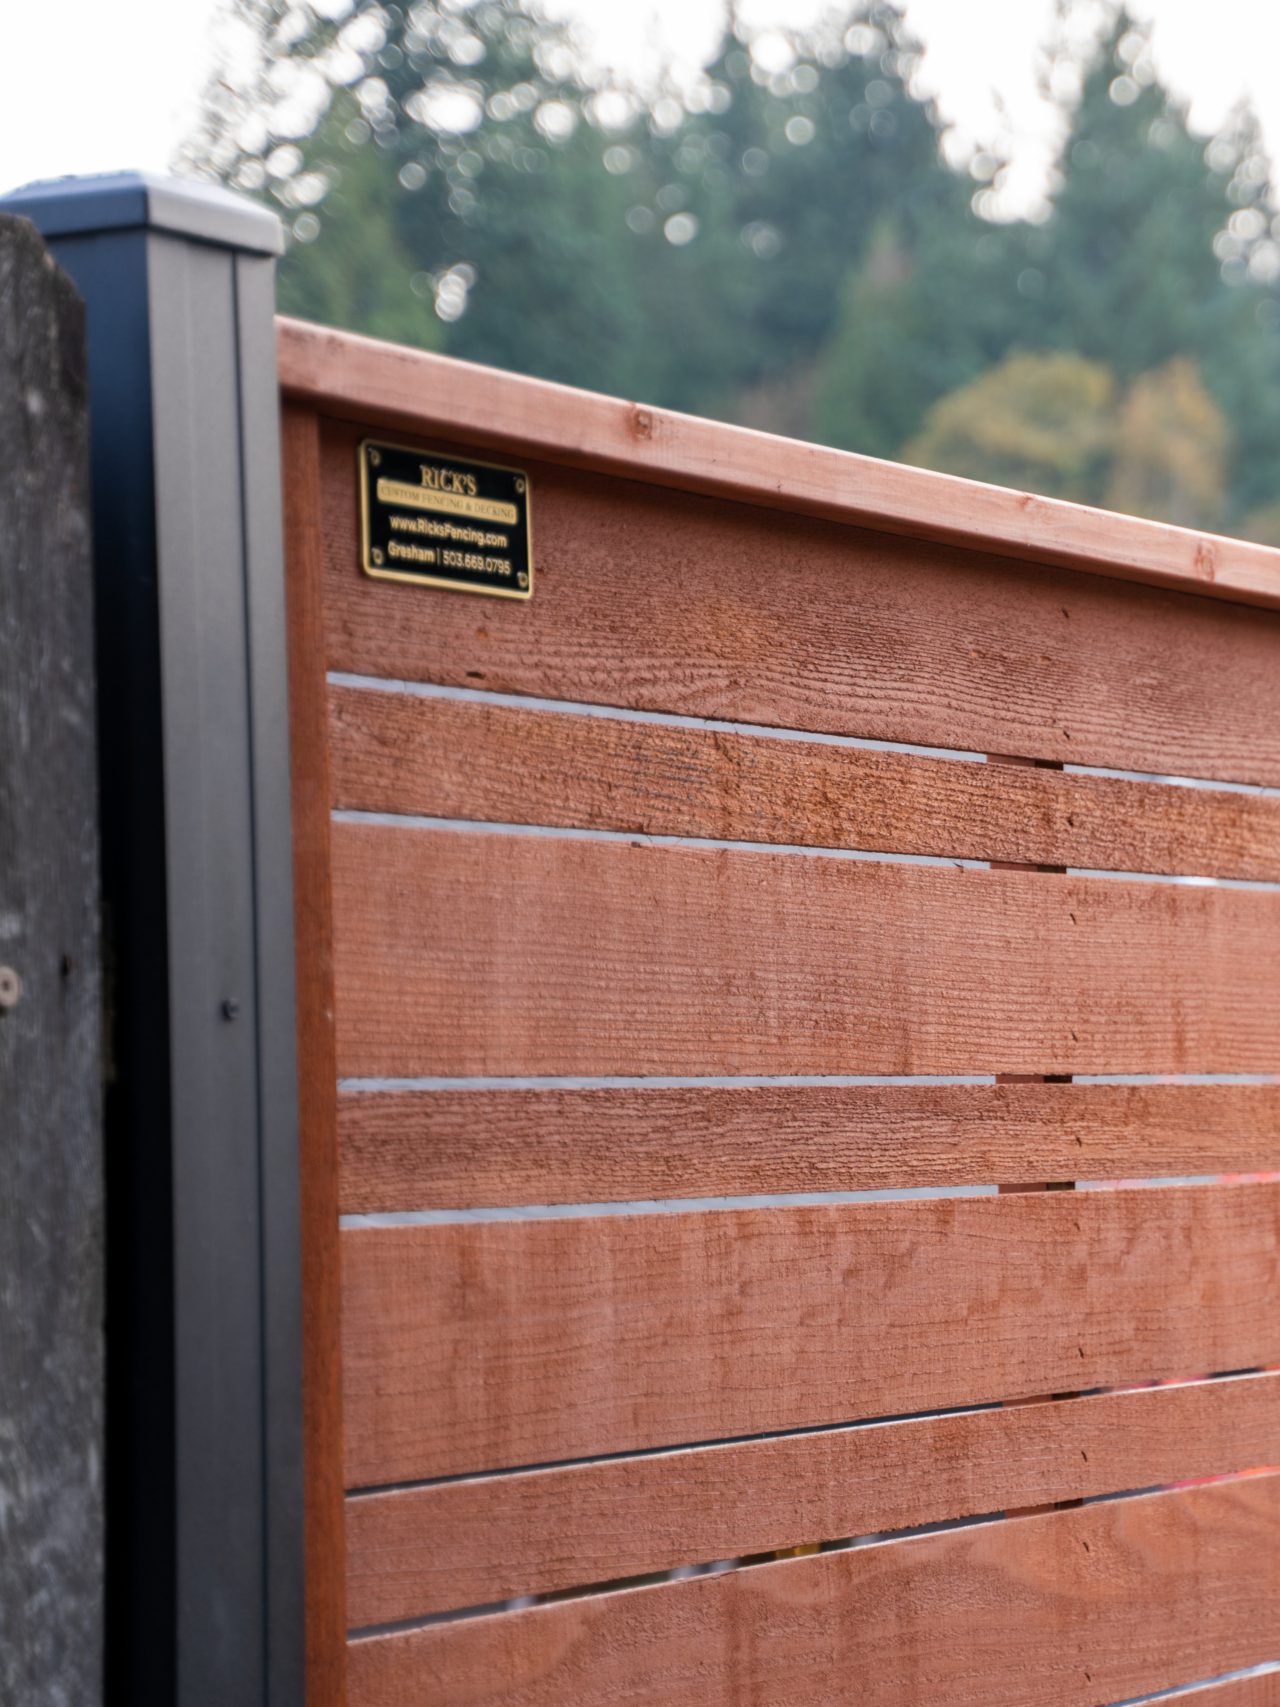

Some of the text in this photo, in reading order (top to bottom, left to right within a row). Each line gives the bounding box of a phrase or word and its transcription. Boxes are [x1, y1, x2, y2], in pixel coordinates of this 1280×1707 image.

[420, 465, 477, 495] RICK'S
[381, 485, 514, 519] CUSTOM FENCING & DECKING
[390, 516, 507, 547] www.RicksFencing.com
[388, 542, 434, 562] Gresham
[443, 550, 511, 575] 503.669.0795
